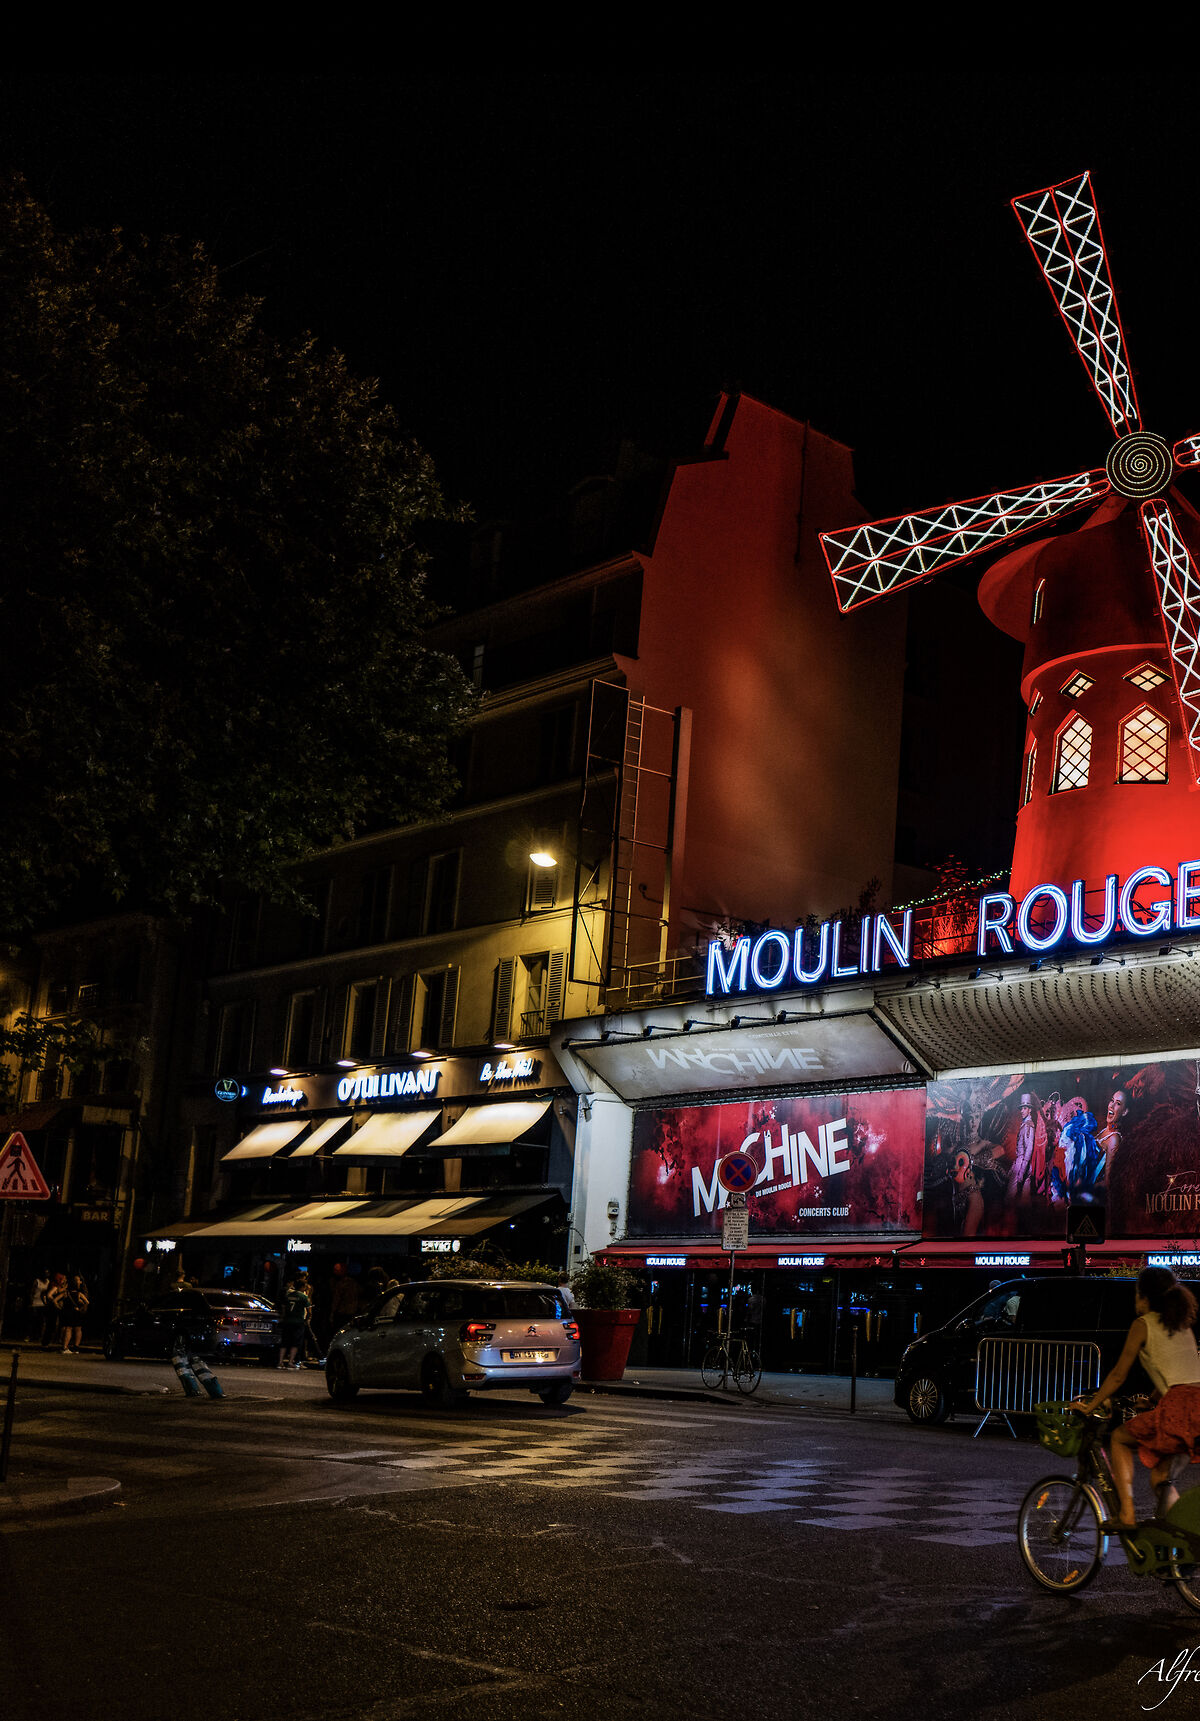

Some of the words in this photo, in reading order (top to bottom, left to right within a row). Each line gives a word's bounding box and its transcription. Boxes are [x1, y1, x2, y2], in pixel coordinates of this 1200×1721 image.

[705, 909, 914, 997] MOULIN
[338, 1069, 441, 1102] O'SULLIVANS
[1145, 1192, 1192, 1214] MOULIN
[81, 1210, 110, 1222] BAR
[799, 1207, 831, 1217] CONCERTS
[832, 1207, 849, 1216] CLUB
[778, 1257, 802, 1266] MOULIN
[803, 1257, 825, 1266] ROUGE
[975, 1256, 1003, 1266] MOULIN
[1004, 1256, 1030, 1266] ROUGE
[1148, 1255, 1181, 1266] MOULIN
